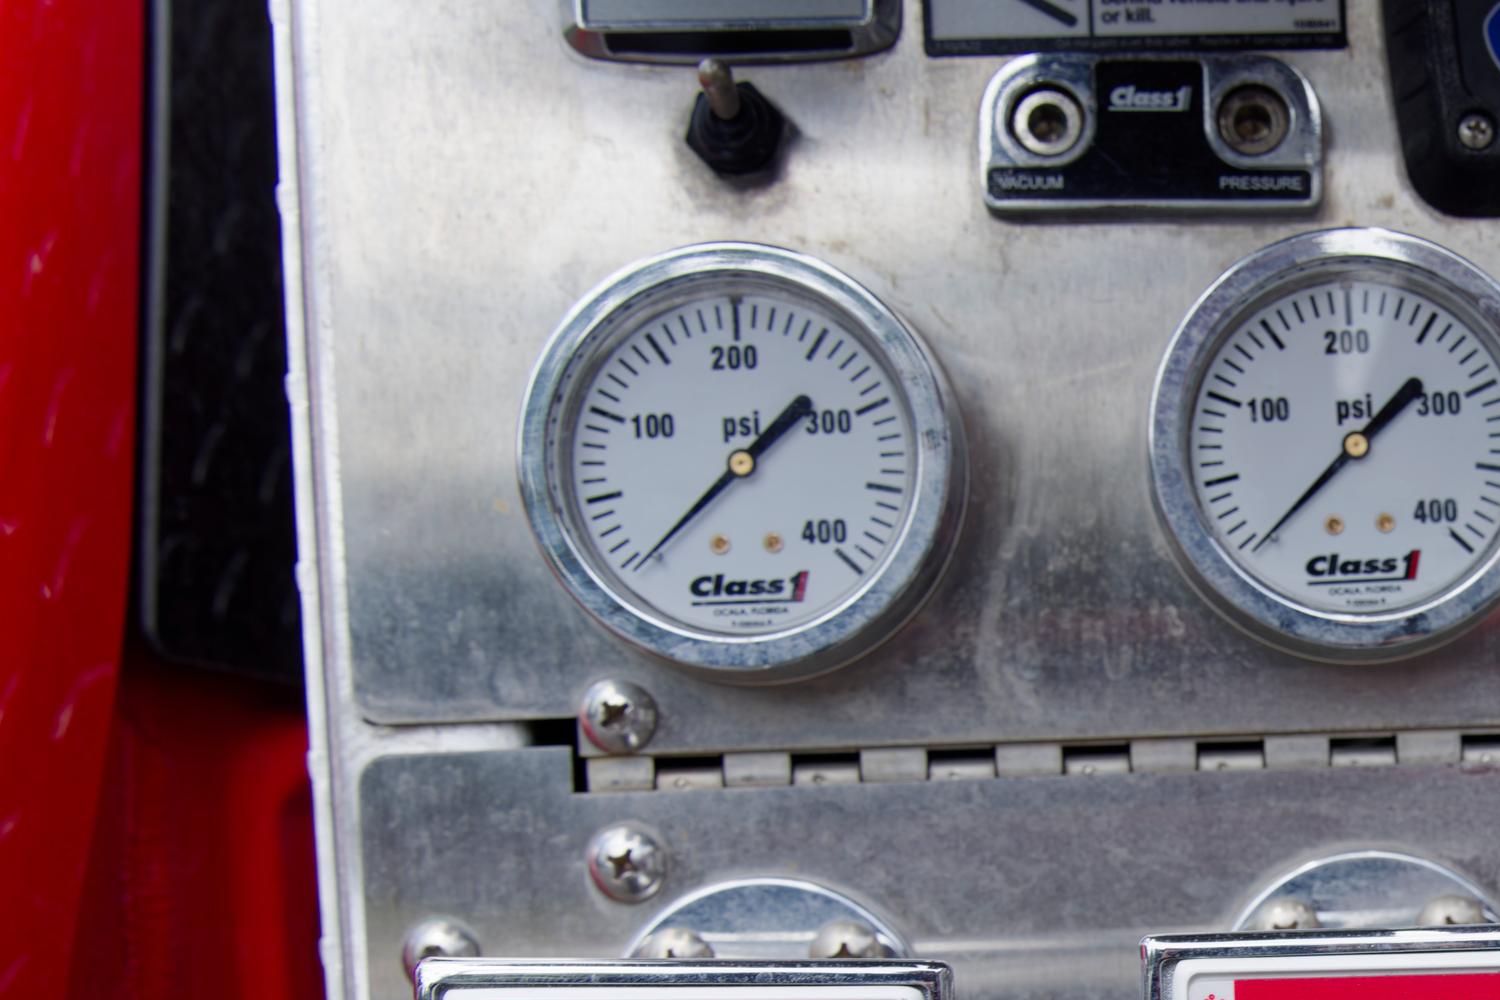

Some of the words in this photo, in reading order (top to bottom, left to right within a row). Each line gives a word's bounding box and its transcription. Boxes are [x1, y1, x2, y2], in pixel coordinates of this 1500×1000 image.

[1102, 10, 1120, 24] or
[1126, 8, 1156, 24] kill.
[1000, 175, 1064, 190] VACUUM
[1219, 176, 1302, 191] PRESSURE
[1324, 330, 1369, 354] 200
[711, 345, 758, 371] 200
[1248, 398, 1289, 422] 100
[1336, 393, 1373, 425] psi
[1417, 391, 1461, 416] 300
[632, 414, 675, 438] 100
[723, 410, 761, 442] psi
[805, 409, 852, 435] 300
[1414, 499, 1458, 524] 400
[802, 520, 847, 544] 400
[1305, 550, 1420, 580] Class1
[690, 571, 809, 602] Class1
